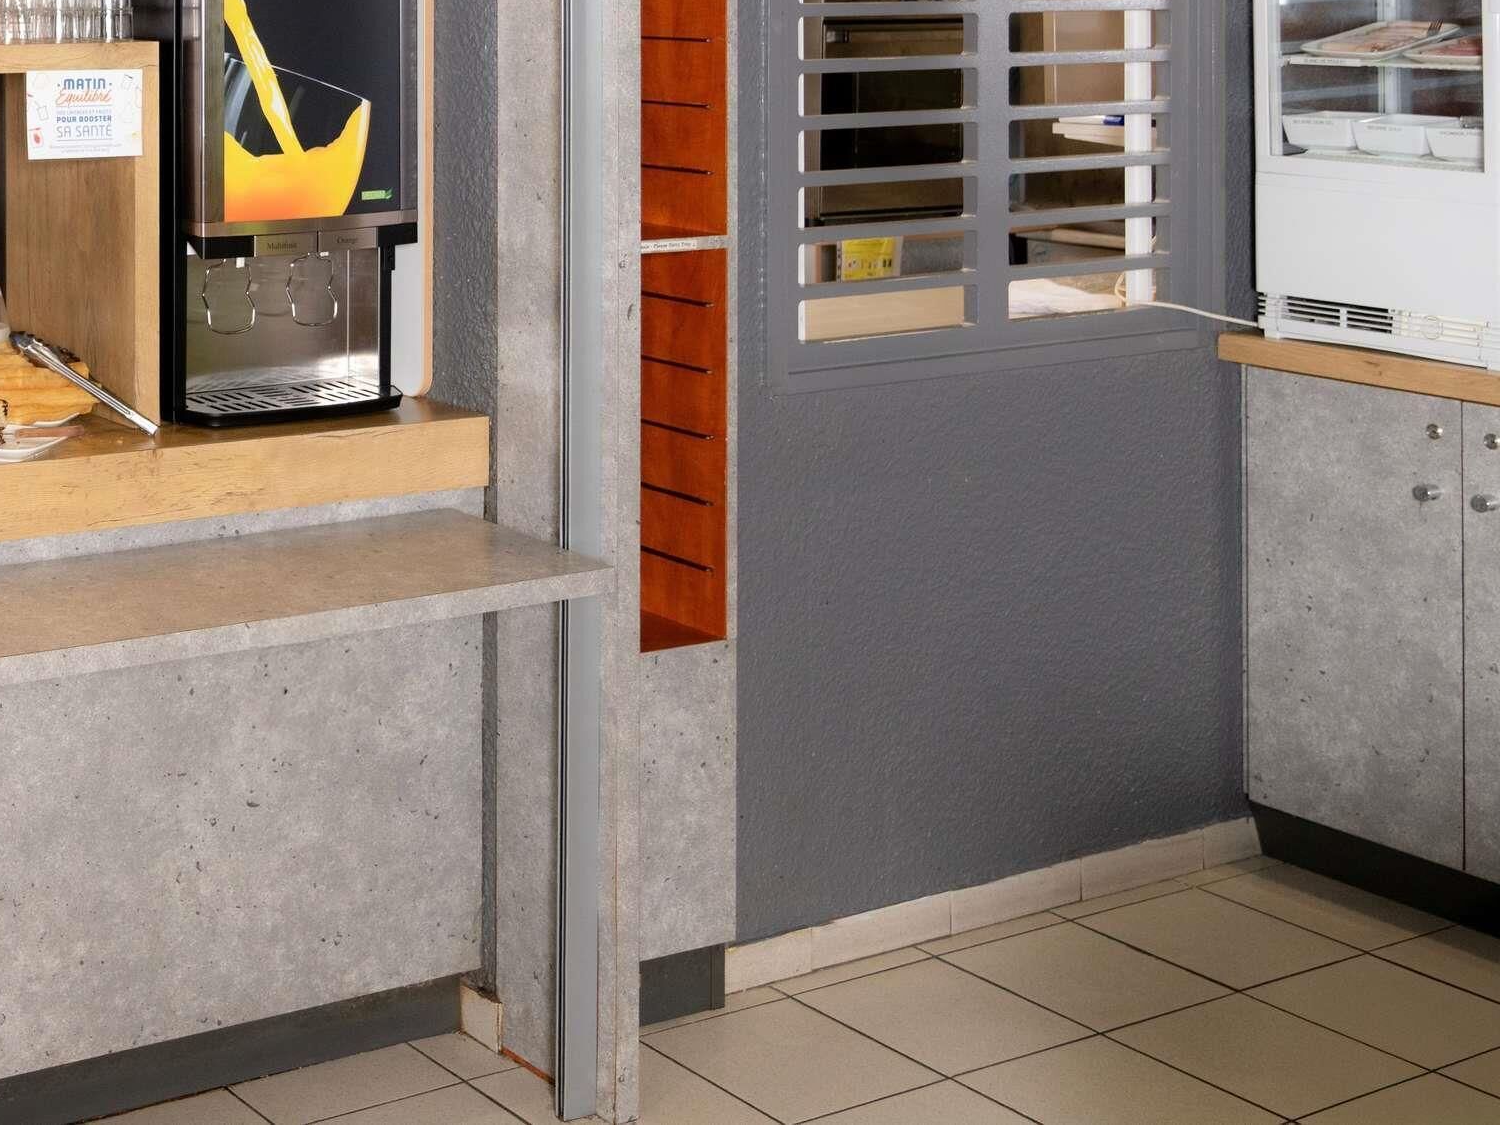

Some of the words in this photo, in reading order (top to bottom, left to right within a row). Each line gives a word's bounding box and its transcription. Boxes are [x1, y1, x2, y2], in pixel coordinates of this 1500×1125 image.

[63, 78, 106, 91] MATIN
[56, 115, 77, 124] POUR
[56, 125, 72, 139] SA
